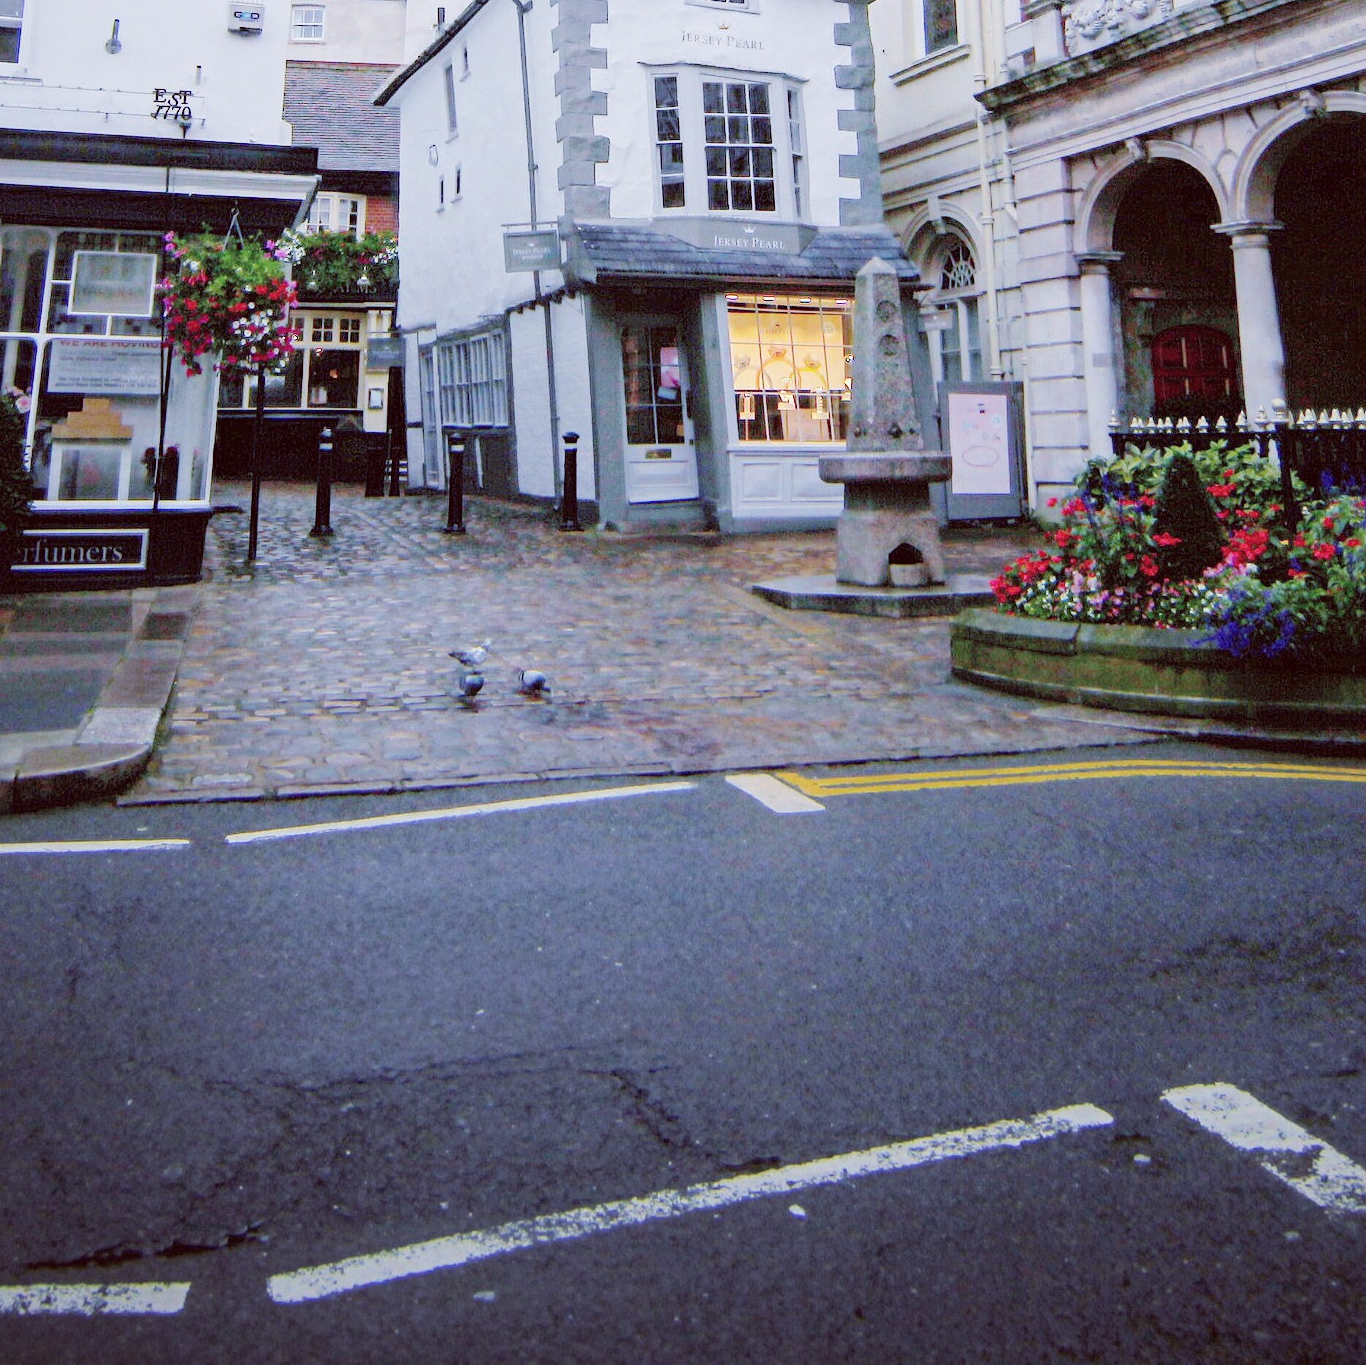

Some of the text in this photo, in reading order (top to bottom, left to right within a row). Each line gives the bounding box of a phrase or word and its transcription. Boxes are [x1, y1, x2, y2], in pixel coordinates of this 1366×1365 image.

[726, 35, 765, 51] PEARL
[714, 235, 786, 250] JERSEY PEARL
